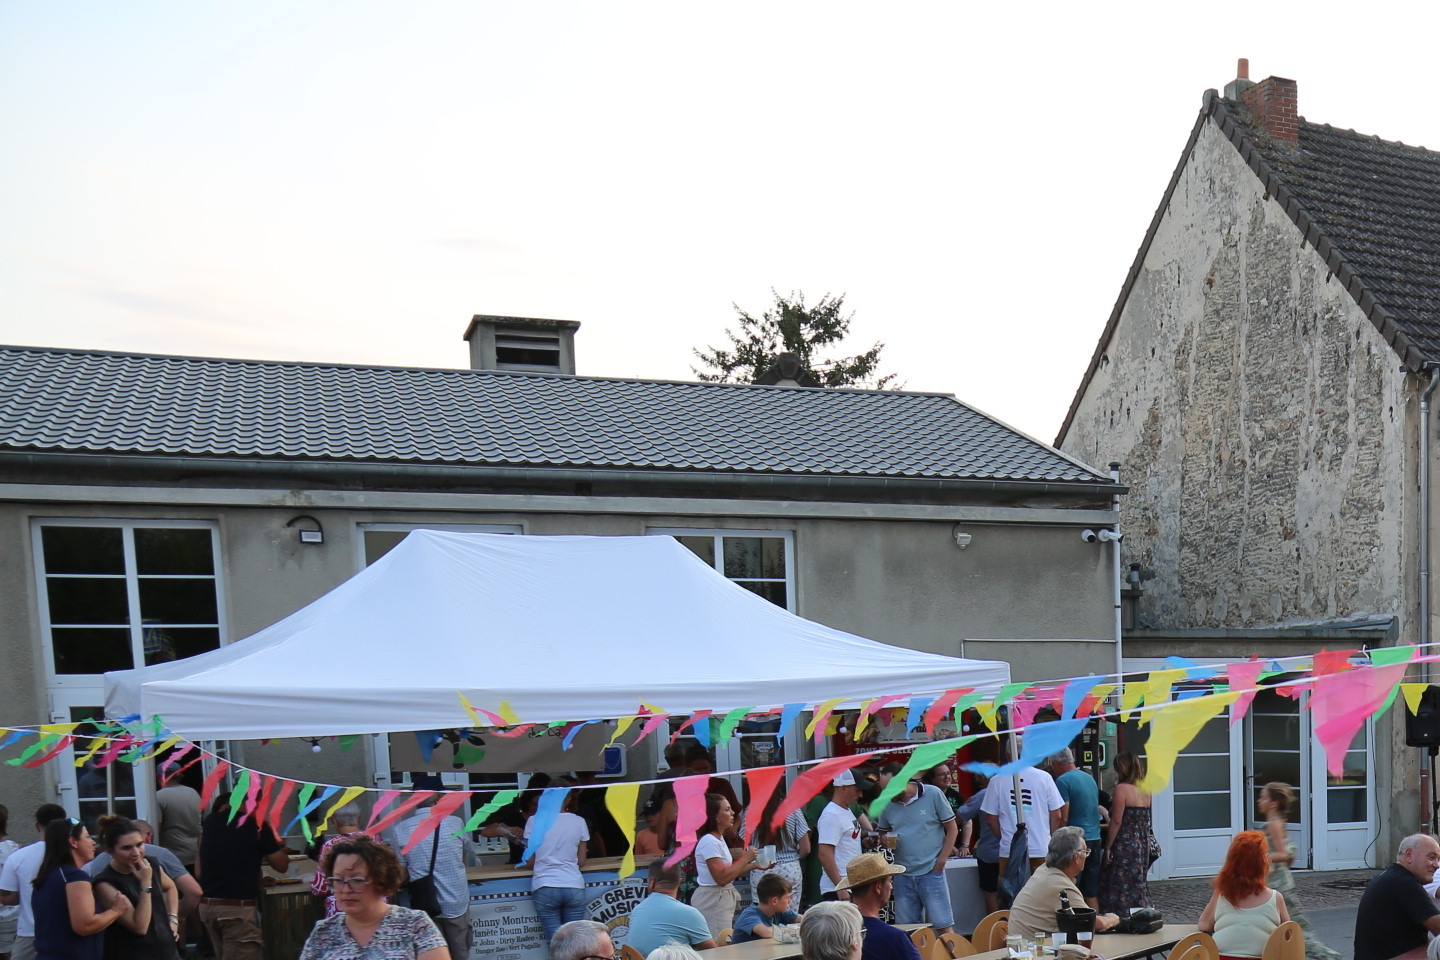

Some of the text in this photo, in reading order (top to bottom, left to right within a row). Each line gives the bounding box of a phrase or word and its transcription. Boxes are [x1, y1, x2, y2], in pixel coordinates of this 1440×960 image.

[588, 899, 602, 911] LES
[472, 929, 498, 938] lanète
[500, 927, 522, 936] Boum
[516, 935, 535, 943] Rodeo
[475, 947, 495, 955] Danger
